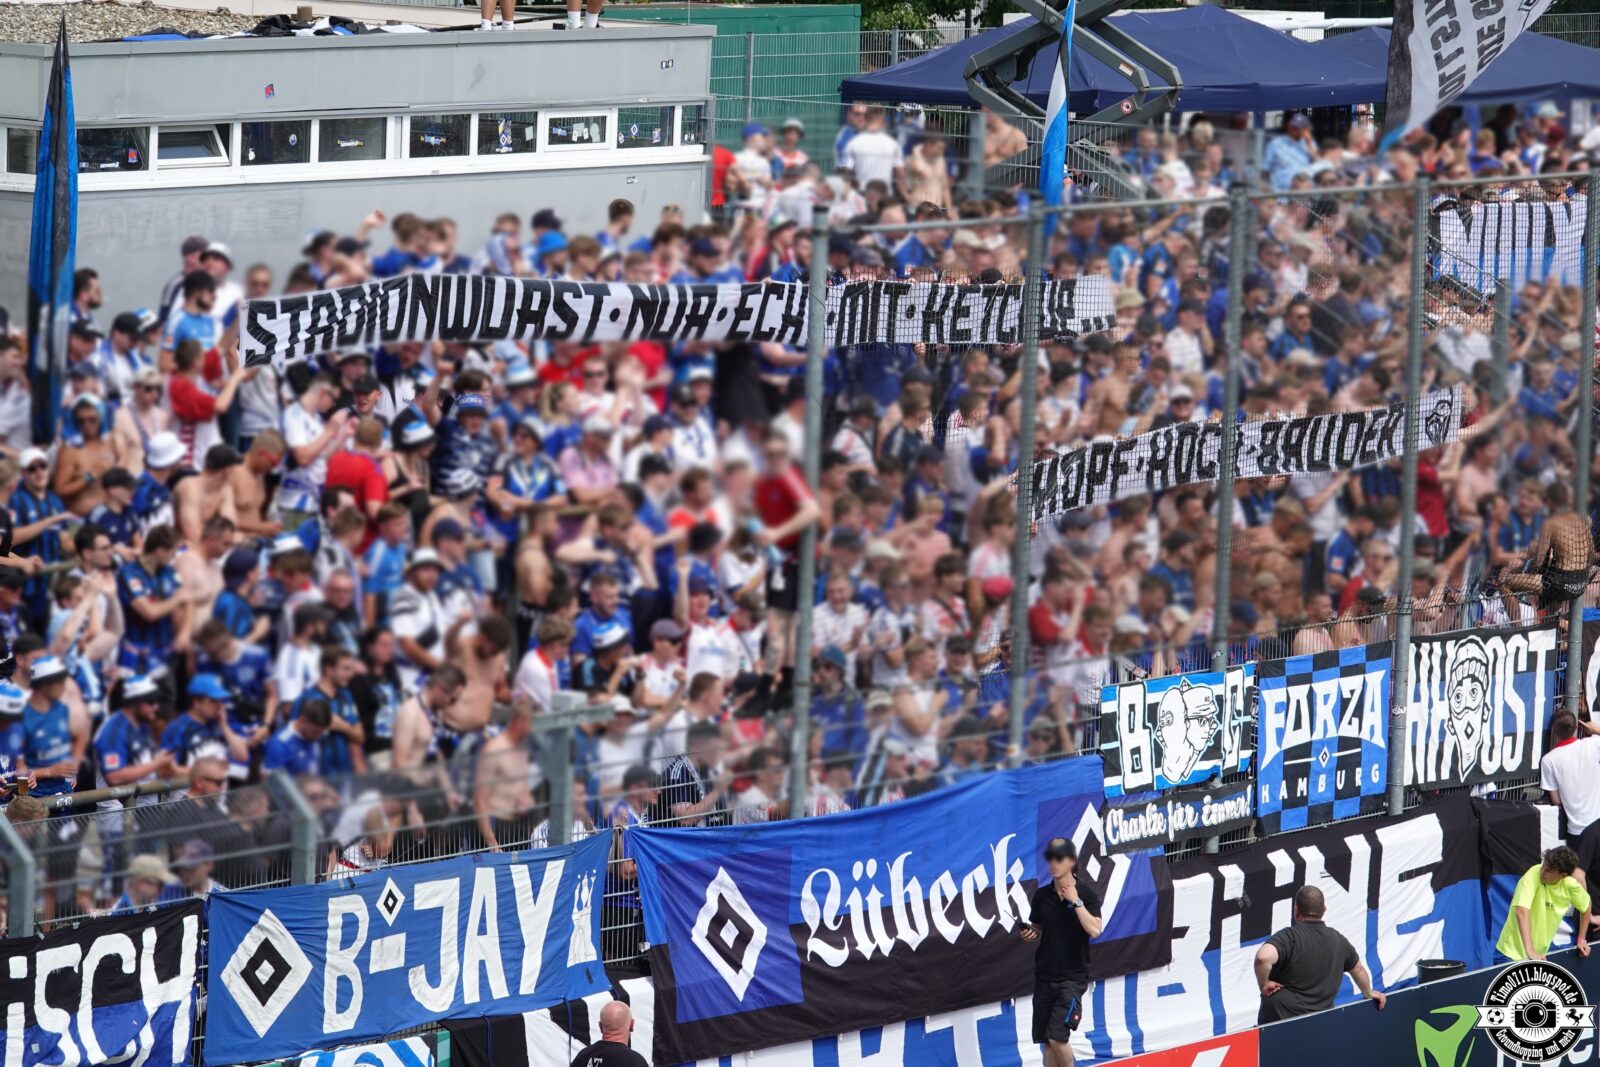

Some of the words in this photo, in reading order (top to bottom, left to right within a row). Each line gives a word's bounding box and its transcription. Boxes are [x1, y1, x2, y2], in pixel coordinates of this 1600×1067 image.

[731, 282, 829, 346] ECH
[1261, 669, 1387, 772] FORZA
[1261, 763, 1380, 805] HAMBURG
[1105, 802, 1167, 845] Charlie
[1167, 800, 1199, 842] für
[800, 833, 1033, 968] Lübeck
